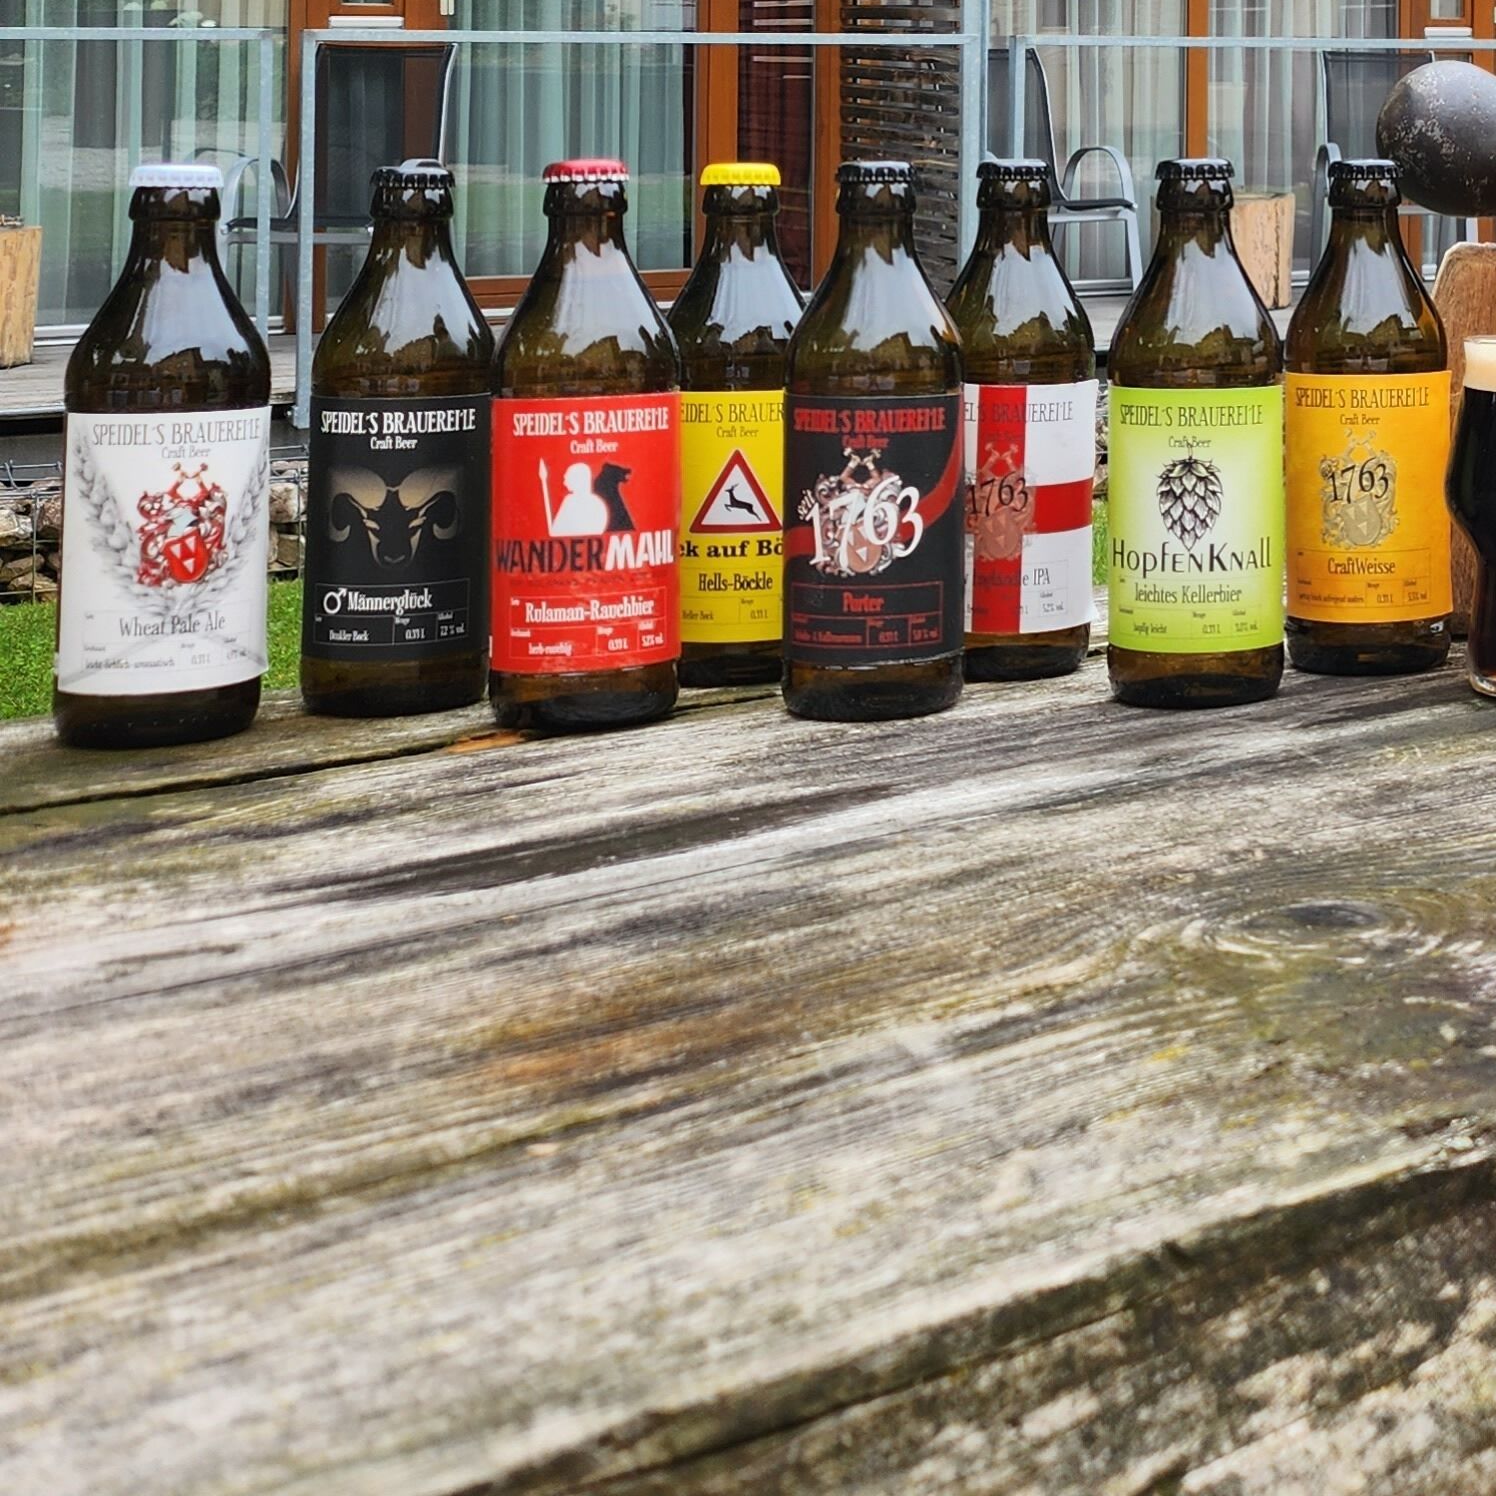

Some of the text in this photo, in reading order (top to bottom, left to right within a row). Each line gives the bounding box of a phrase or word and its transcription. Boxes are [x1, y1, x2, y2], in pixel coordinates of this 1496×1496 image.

[1340, 414, 1381, 425] Craft Beer
[370, 436, 417, 450] Craft Beer
[569, 439, 618, 454] Craft Beer
[1327, 456, 1389, 504] 1763
[967, 470, 1028, 517] 1763
[805, 475, 923, 569] 1763
[707, 540, 750, 558] auf
[1328, 557, 1396, 575] CraftWeisse
[698, 571, 773, 592] Hells-Böckle
[1033, 568, 1051, 586] IPA
[348, 587, 433, 616] Männerglück
[1135, 582, 1242, 604] leichtes Kellerbier
[120, 610, 226, 637] Wheat Pale Ale
